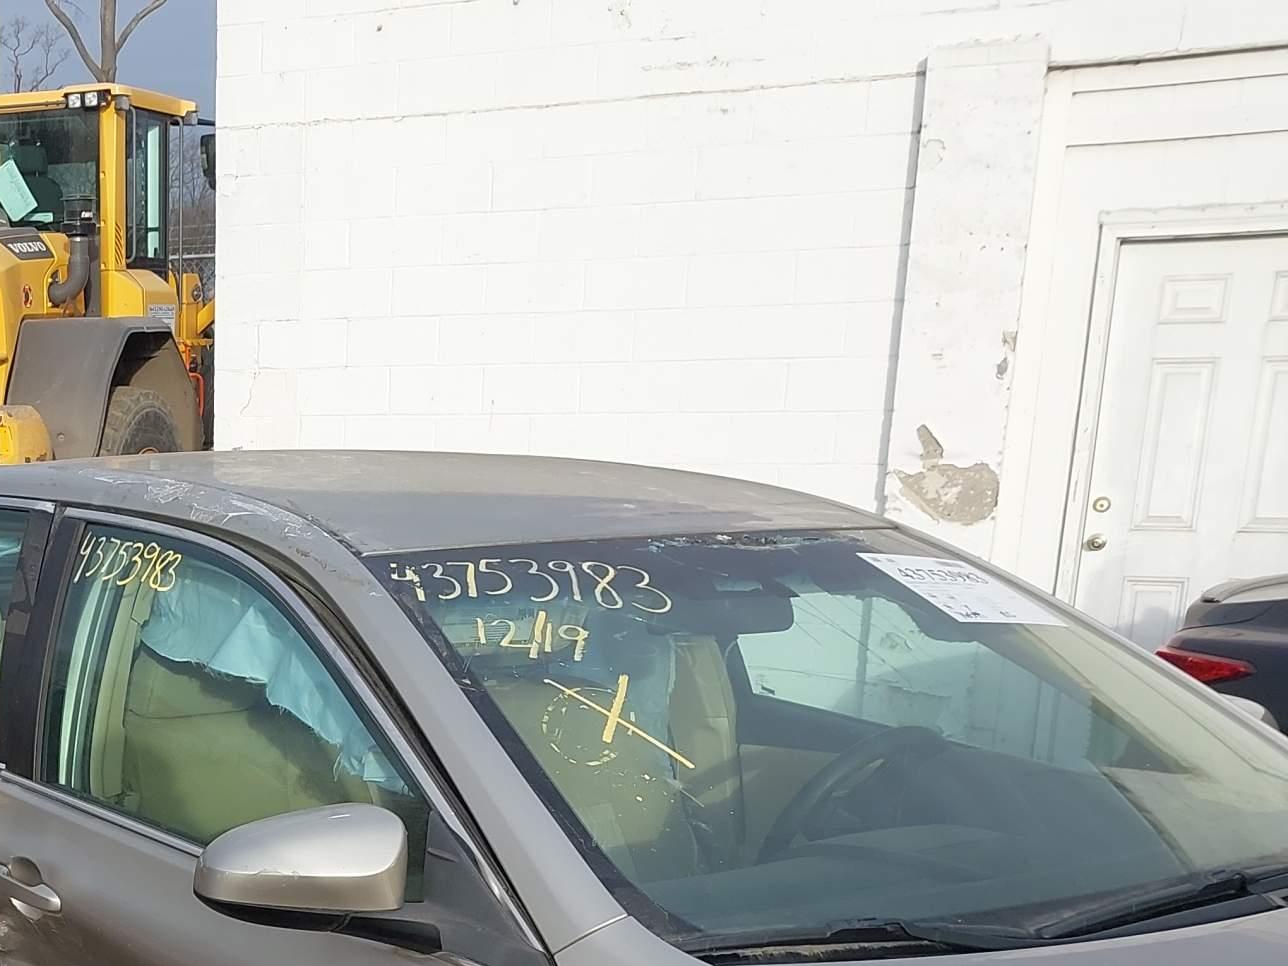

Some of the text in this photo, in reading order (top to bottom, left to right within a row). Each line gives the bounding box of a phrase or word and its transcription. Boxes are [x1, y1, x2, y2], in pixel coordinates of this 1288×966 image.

[7, 241, 47, 253] VOLVO
[73, 530, 182, 592] 43753983
[390, 558, 672, 613] 43753983
